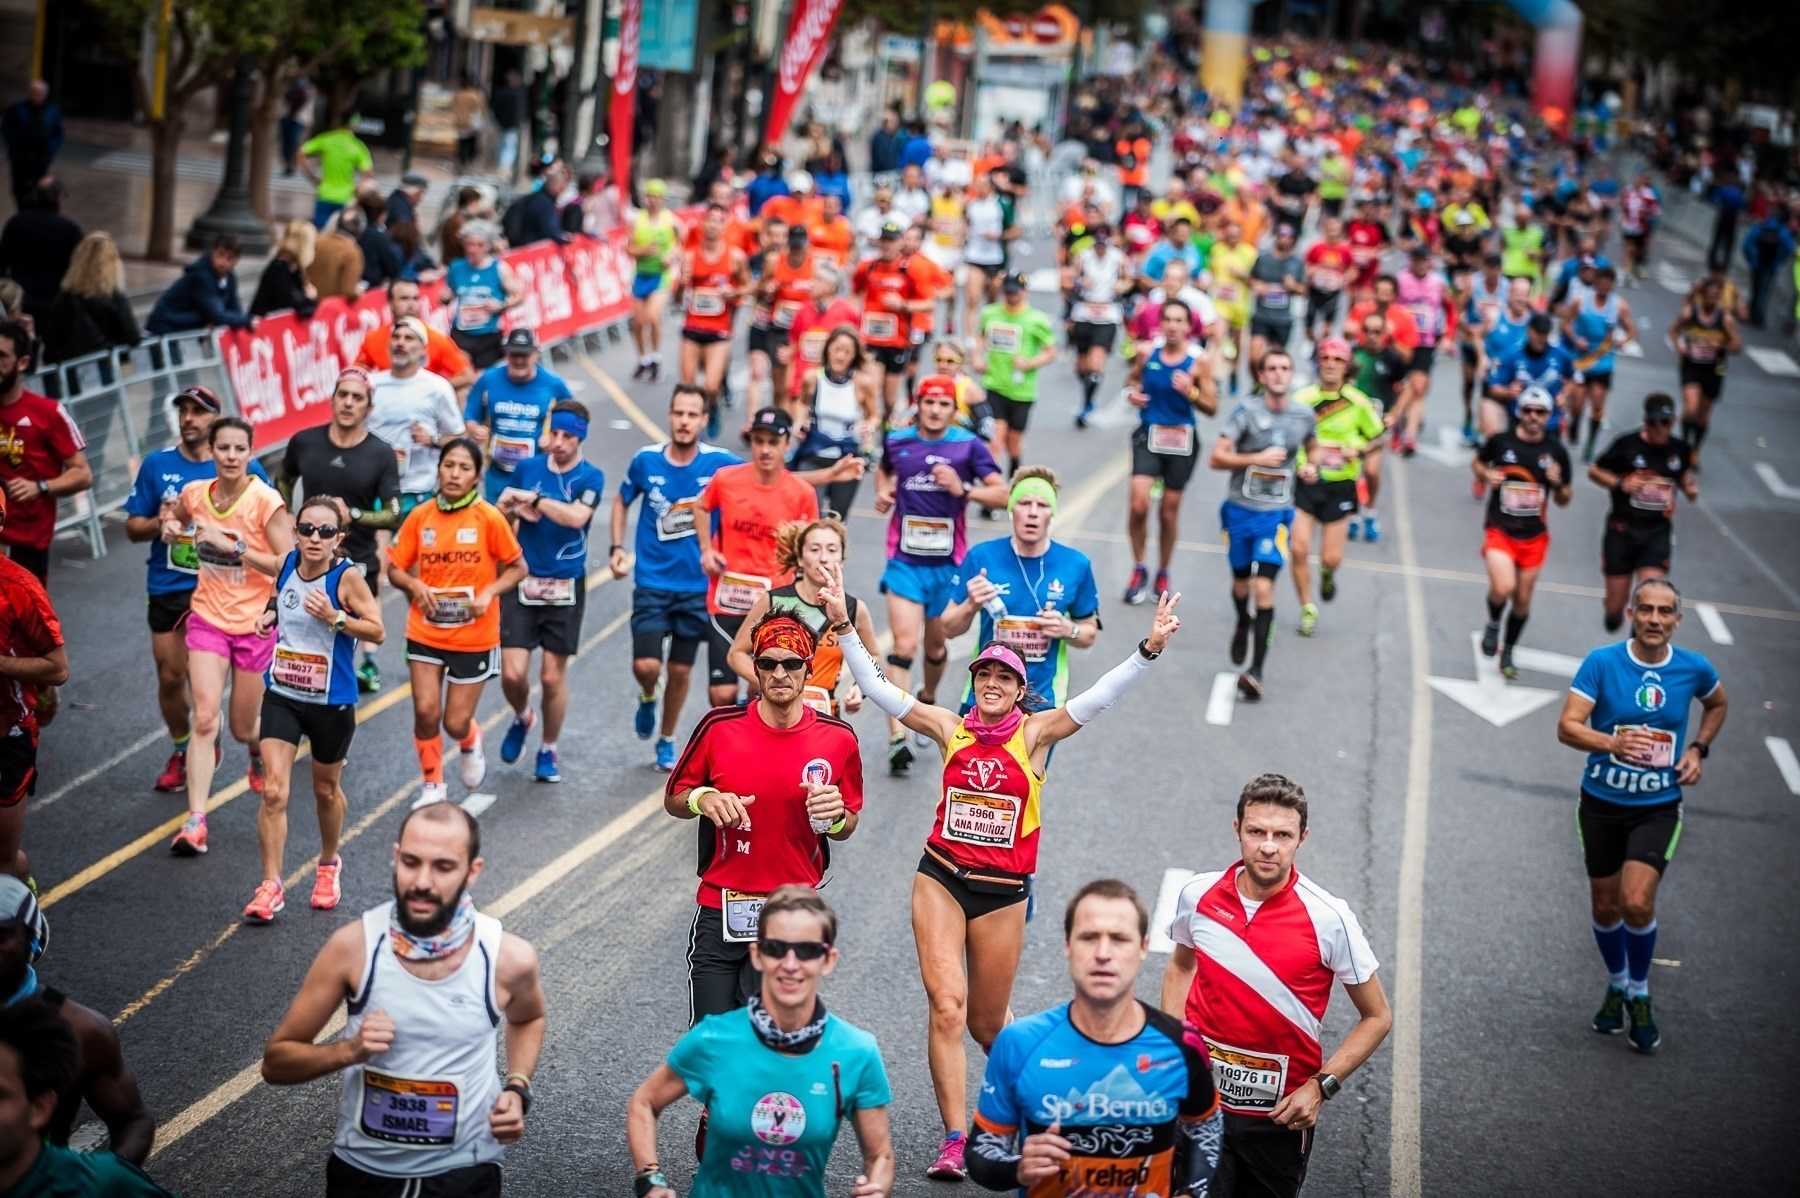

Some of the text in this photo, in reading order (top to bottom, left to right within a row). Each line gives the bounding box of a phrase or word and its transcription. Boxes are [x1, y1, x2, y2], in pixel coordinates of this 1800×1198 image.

[969, 807, 994, 820] 5960
[954, 818, 1006, 836] ANA MUÑOZ
[736, 840, 750, 854] M
[1218, 1064, 1258, 1084] 10976
[1219, 1078, 1254, 1098] ILARIO
[389, 1095, 428, 1112] 3938
[382, 1113, 430, 1133] ISMAEL
[1085, 1161, 1149, 1187] rehab
